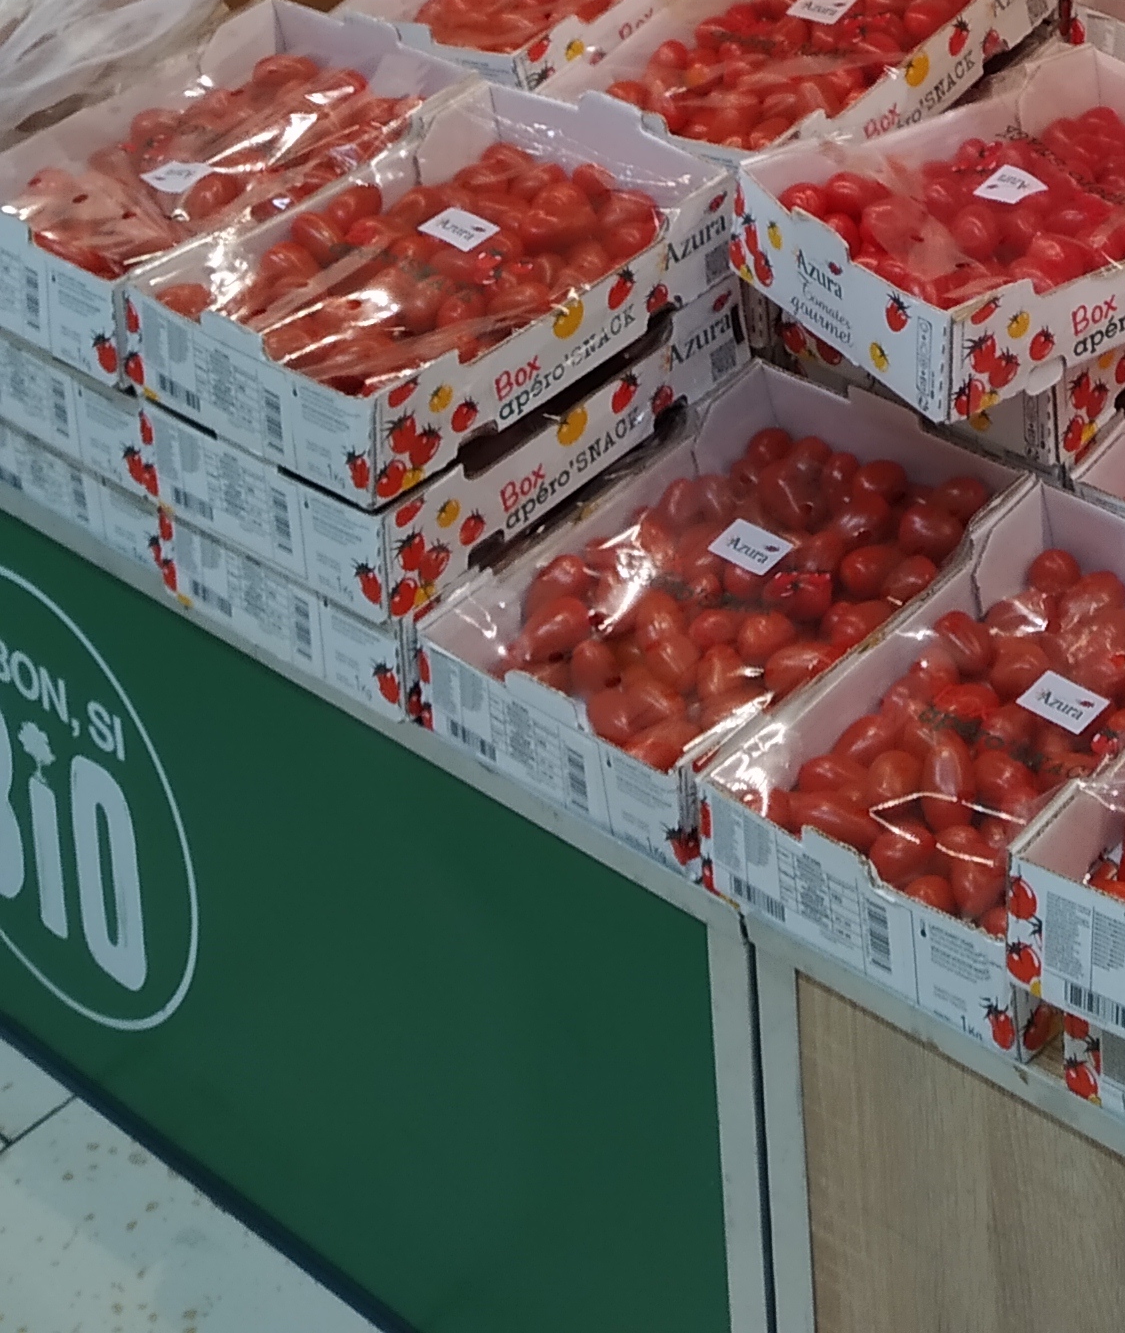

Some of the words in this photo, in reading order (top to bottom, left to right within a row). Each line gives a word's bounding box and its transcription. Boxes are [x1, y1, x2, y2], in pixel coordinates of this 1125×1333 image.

[664, 215, 728, 271] Azura
[797, 248, 844, 301] Azura
[1071, 294, 1118, 337] Box
[498, 303, 637, 421] apéro'SNACK
[670, 313, 732, 372] Azura
[494, 354, 542, 402] Box
[499, 463, 548, 514] Box
[726, 536, 769, 565] Azura
[87, 700, 126, 762] SI
[1038, 690, 1084, 722] Azura
